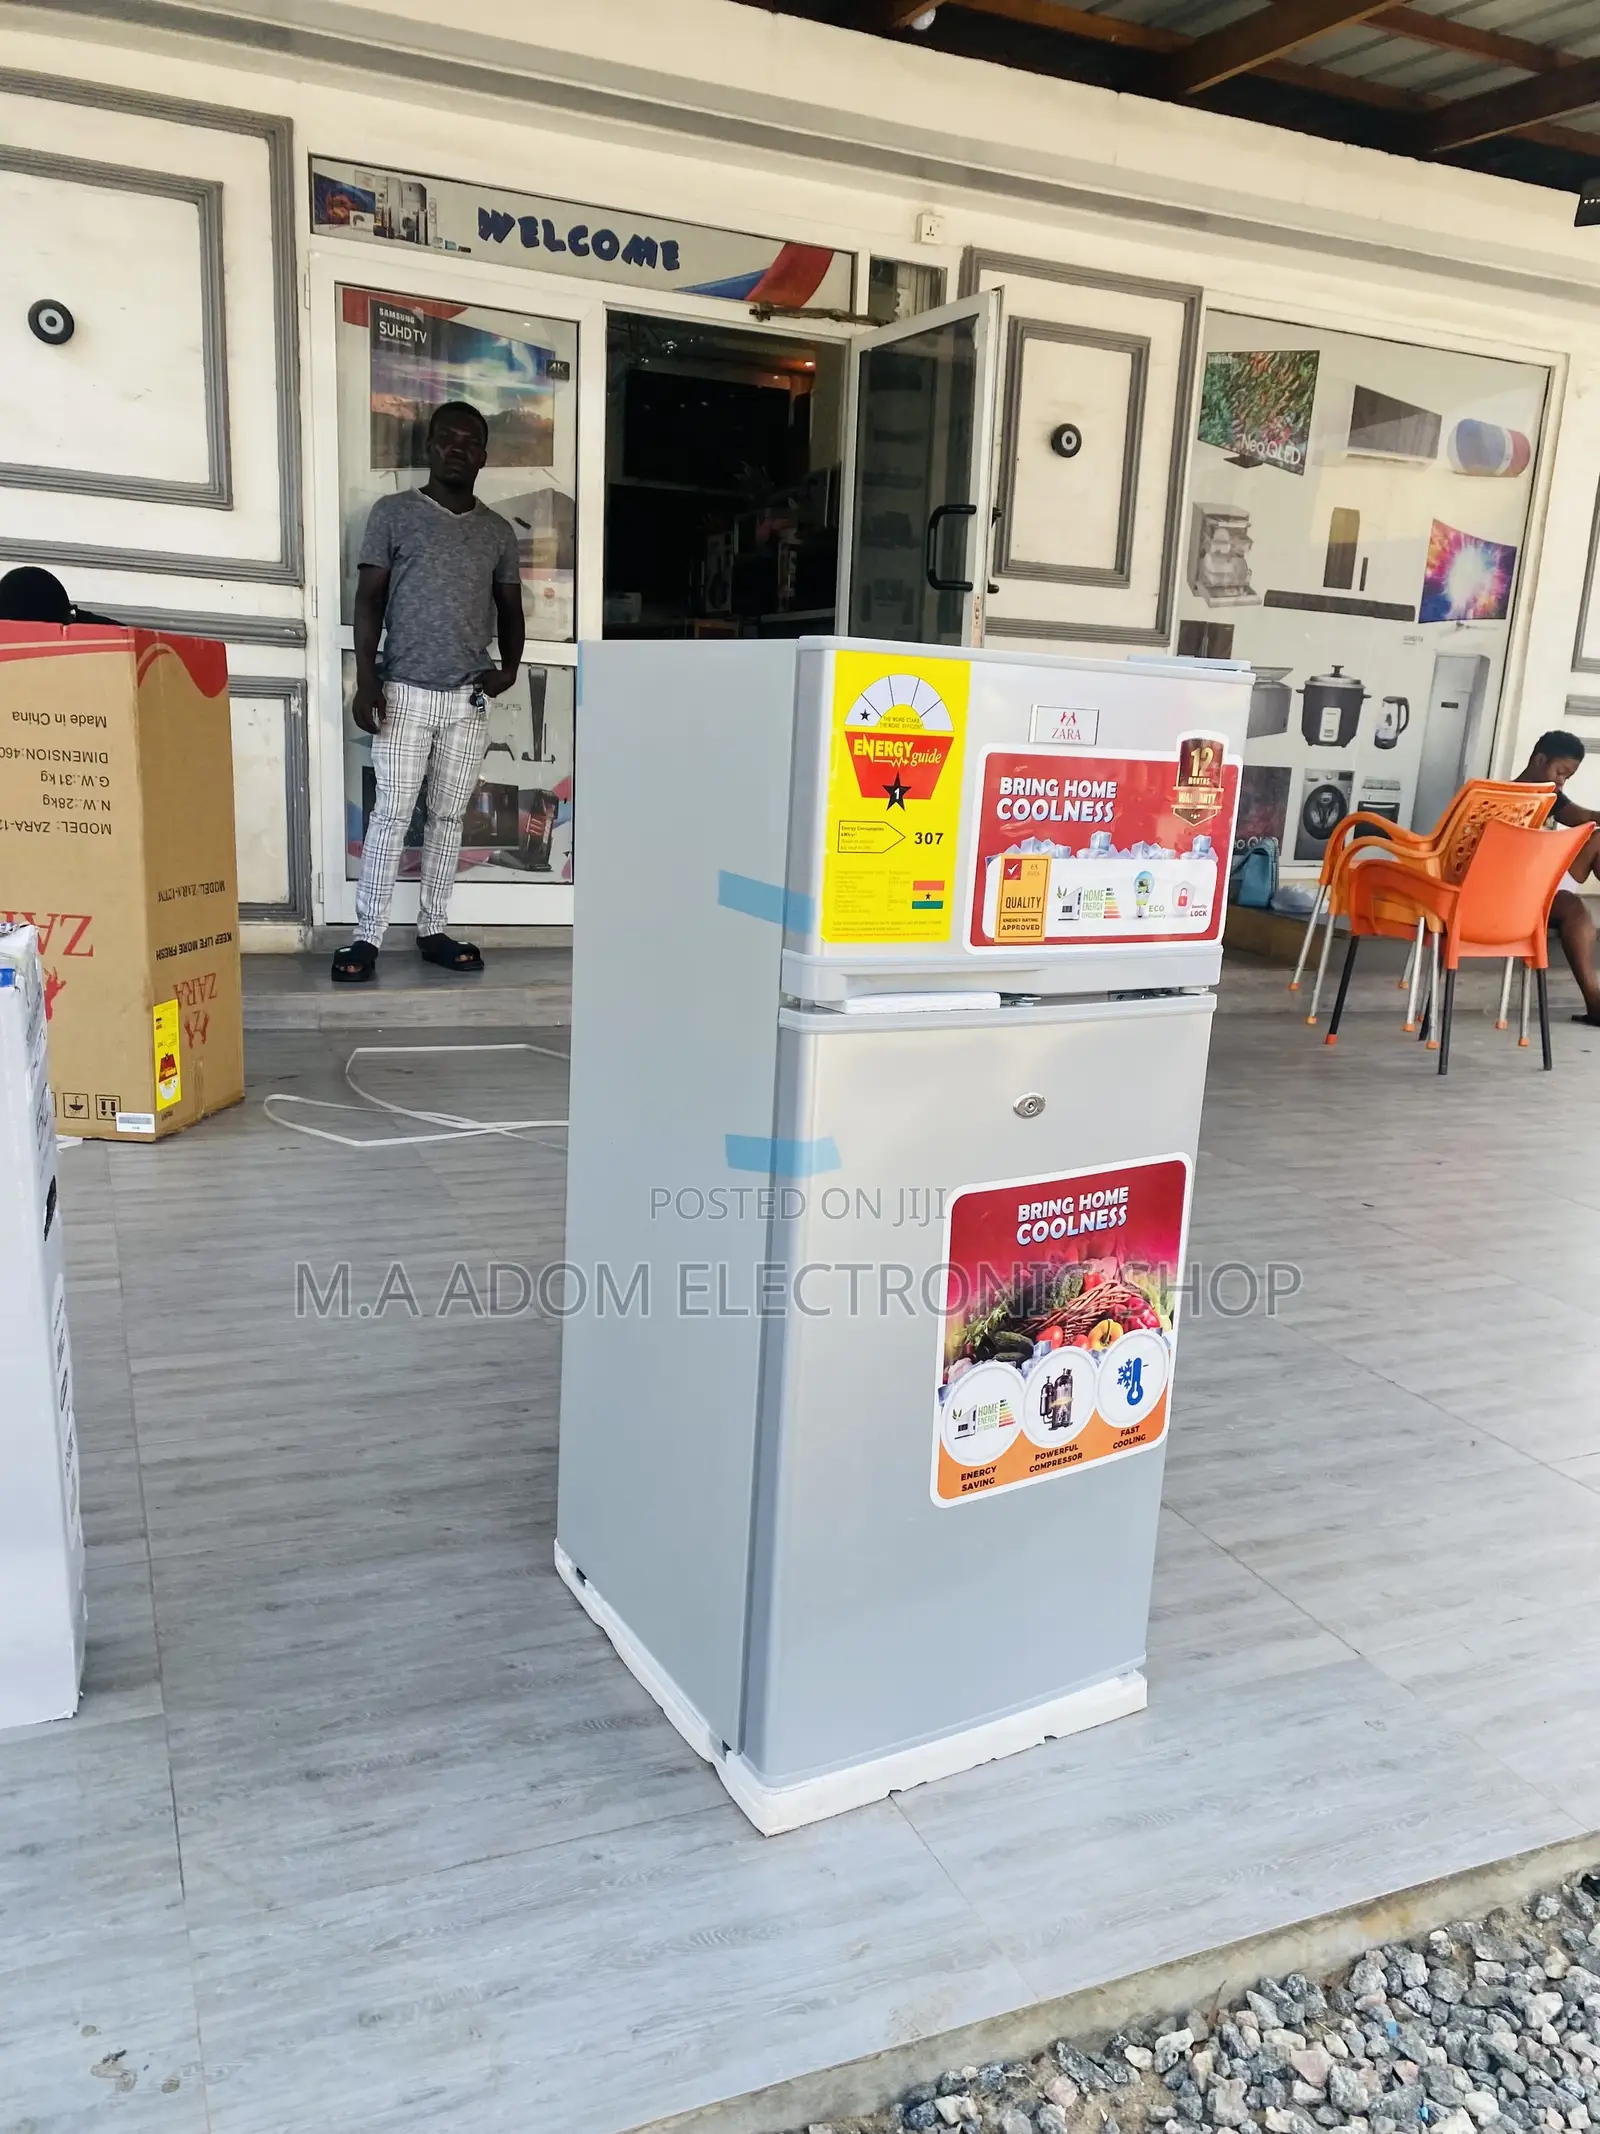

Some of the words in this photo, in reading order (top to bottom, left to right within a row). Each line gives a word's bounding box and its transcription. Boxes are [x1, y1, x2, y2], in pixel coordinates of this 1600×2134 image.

[477, 206, 681, 271] WELCOME
[379, 307, 415, 324] SAMSUNG
[549, 363, 565, 373] 4K
[1241, 433, 1265, 453] Neo
[1267, 441, 1301, 465] QLED
[12, 711, 51, 726] China
[54, 714, 67, 727] in
[70, 714, 108, 728] Made
[1051, 727, 1082, 741] ZARA
[853, 734, 914, 762] ENERGY
[910, 748, 942, 767] guide
[1190, 746, 1214, 777] 12
[894, 787, 900, 800] 1
[999, 777, 1059, 797] BRING
[1064, 779, 1117, 799] HOME
[1178, 791, 1217, 805] WAANTY
[996, 798, 1114, 824] COOLNESS
[55, 821, 112, 835] MODEL:
[914, 832, 944, 845] 307
[1083, 889, 1105, 901] HOME
[1005, 896, 1042, 909] QUALITY
[1082, 902, 1104, 911] ENERGY
[1148, 904, 1165, 913] ECO
[199, 936, 214, 949] LIFE
[214, 931, 233, 945] KEEP
[155, 945, 178, 960] FRESH
[178, 940, 198, 954] MORE
[172, 972, 218, 1011] ZARA
[1017, 1197, 1074, 1223] BRING
[1078, 1186, 1129, 1211] HOME
[1016, 1205, 1128, 1246] COOLNESS
[977, 1403, 999, 1417] HOME
[977, 1415, 998, 1425] ENERGY
[1120, 1425, 1141, 1437] FAST
[1112, 1434, 1146, 1449] COOLING
[1034, 1444, 1079, 1461] POWERFUL
[1029, 1452, 1083, 1473] COMPRESSOR
[960, 1465, 997, 1481] ENERGY
[961, 1477, 995, 1492] SAVING
